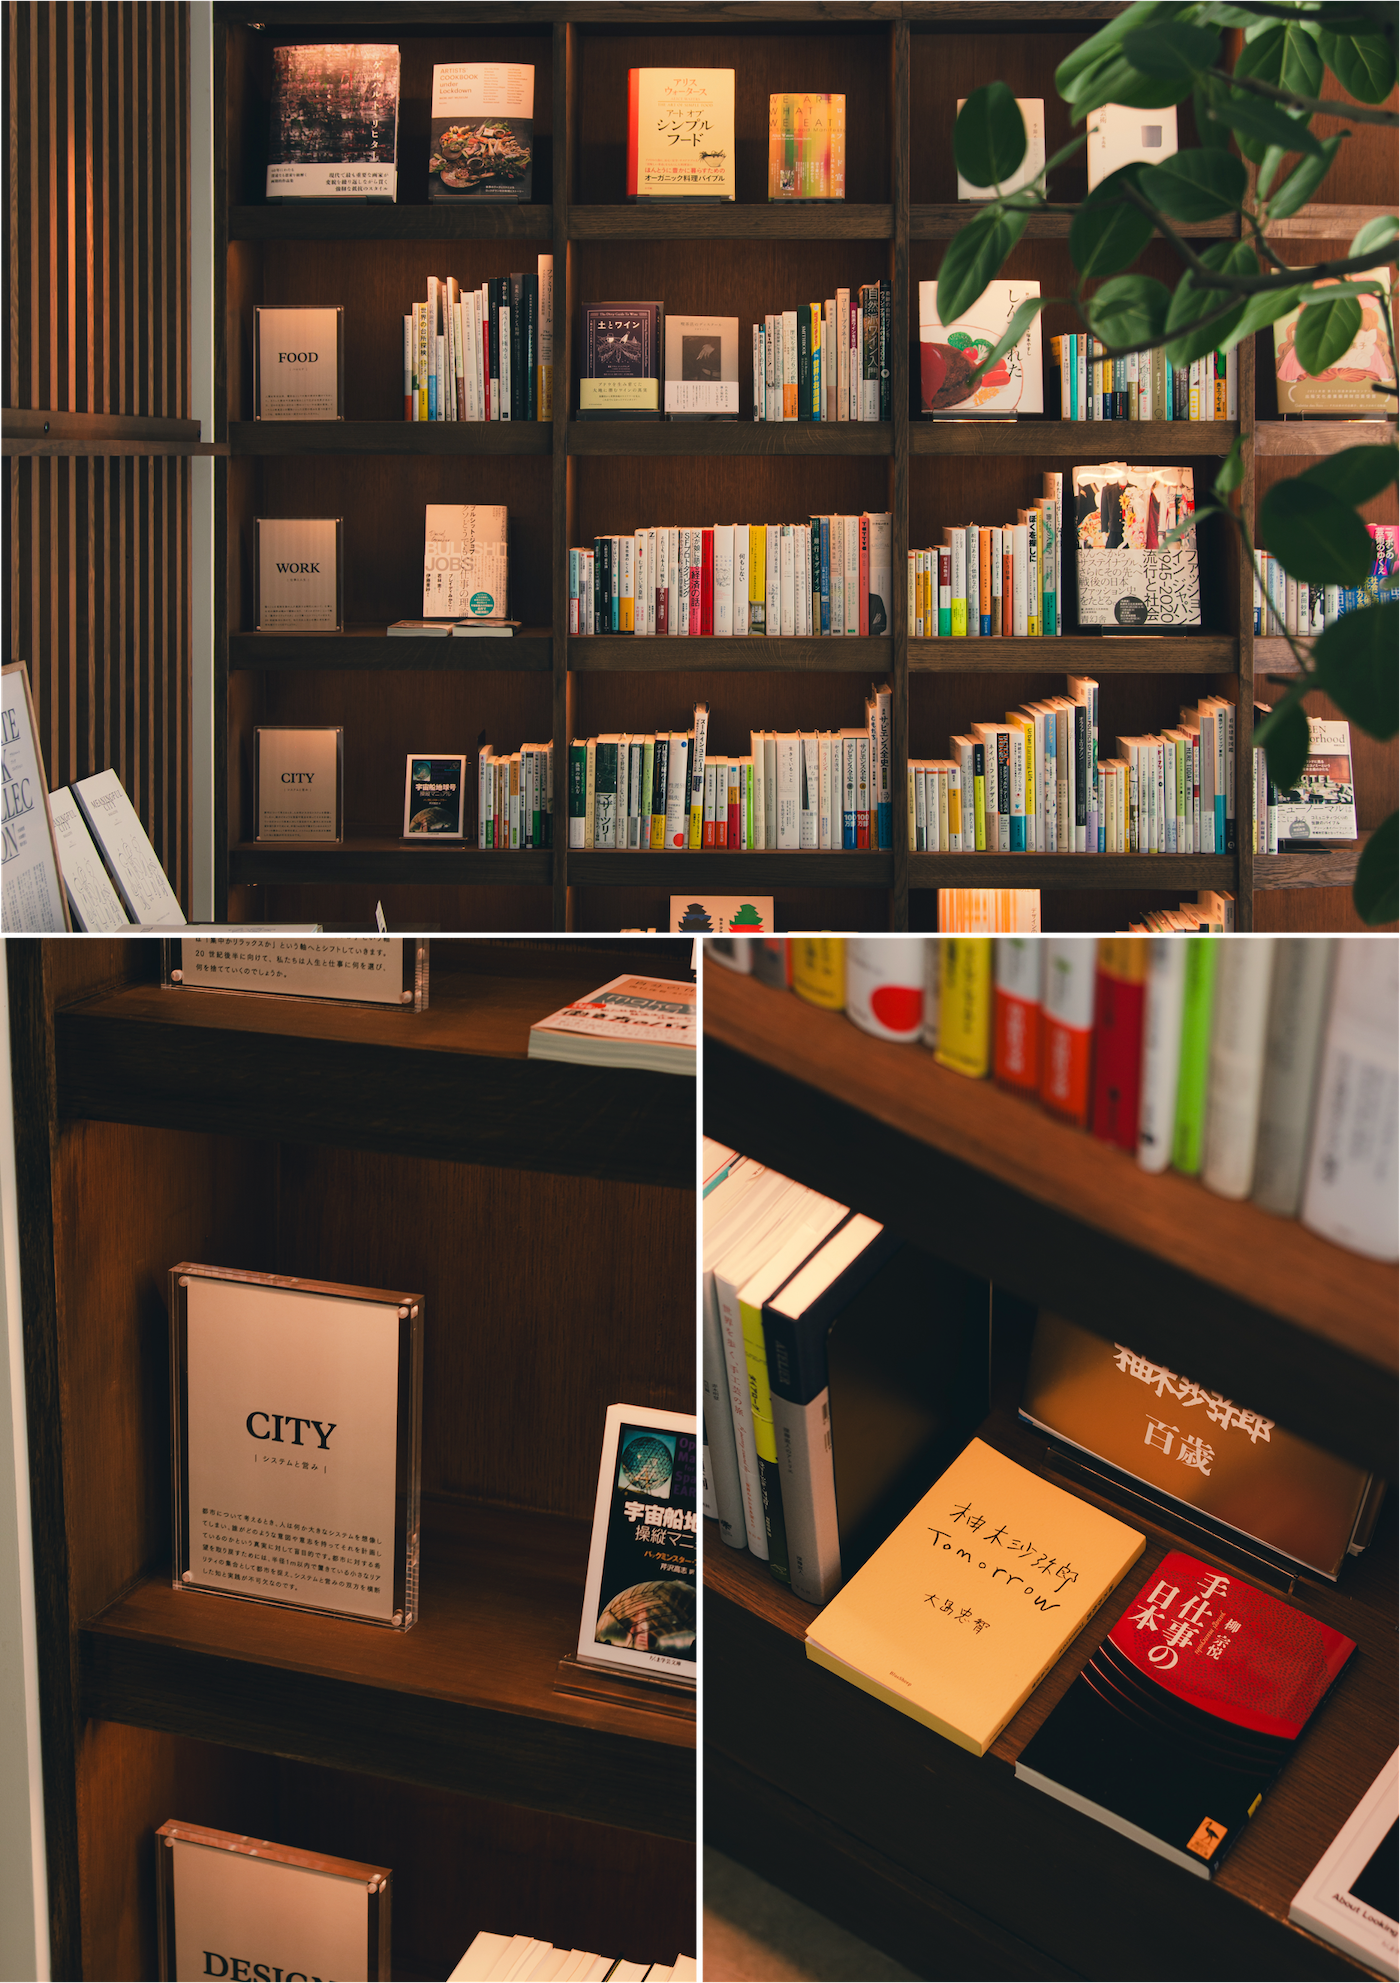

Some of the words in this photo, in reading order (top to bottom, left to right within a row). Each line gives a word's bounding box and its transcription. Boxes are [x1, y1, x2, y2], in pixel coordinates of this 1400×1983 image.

[664, 87, 707, 96] ウォータース
[673, 78, 697, 86] アリス
[370, 60, 382, 161] ゲルハルト・リヒター
[770, 95, 788, 104] WE
[804, 95, 832, 104] ARE
[770, 107, 812, 115] WHAT
[657, 118, 714, 132] シンプル
[804, 118, 832, 126] EAT
[667, 133, 703, 147] フード
[835, 96, 843, 196] スローフード宣言
[597, 320, 640, 330] 土とワイン
[868, 288, 878, 379] 自然派ワイン入門
[278, 353, 318, 363] FOOD
[276, 563, 320, 574] WORK
[426, 557, 474, 571] JOBS
[459, 505, 470, 617] クソどうでもいい仕事の理論
[1078, 559, 1142, 568] サステイナブル、
[1079, 568, 1143, 577] さらにその先へ
[1080, 577, 1129, 587] 戦後の日本
[1080, 586, 1137, 596] ファッション史
[1143, 550, 1159, 621] 流行と社会
[1159, 550, 1173, 623] 1945-2020
[1185, 550, 1201, 622] ファッション
[1080, 596, 1116, 606] をたどる。
[1081, 615, 1106, 623] 青幻舎
[880, 716, 889, 767] サピエンス全史
[1310, 734, 1345, 743] orhood
[281, 773, 315, 783] CITY
[91, 790, 123, 809] MEANINGFUL
[103, 801, 117, 812] CITY
[1278, 805, 1344, 814] ニューノーマル
[600, 795, 612, 842] マザーツリー
[196, 964, 288, 978] 何を捨てていくのでしょうか。
[209, 951, 387, 972] 世紀後半に向けて、私たちは人生と仕事に何を選び、
[722, 1304, 744, 1418] 世界を歩く、手工芸の旅
[775, 1340, 790, 1385] ATELIER
[1112, 1342, 1276, 1444] 柚木沙弥郎
[246, 1411, 337, 1450] CITY
[1144, 1413, 1216, 1477] 百歳
[262, 1455, 318, 1471] システムと営み
[202, 1508, 382, 1545] 都市について考えるとき、人は何か大きなシステムを想像し
[624, 1502, 699, 1533] 宇宙船地
[202, 1520, 382, 1557] てしまい、誰がどのような意図や意志を持ってそれを計画し
[950, 1502, 1078, 1592] 柚木沙弥郎
[202, 1532, 381, 1569] ているのかという真実に対して盲目的です。都市に対する希
[202, 1556, 381, 1594] リティの集合として都市を捉え、システムと営みの双方を横断
[202, 1568, 298, 1591] した知と実践が不可欠なのです。
[927, 1528, 1060, 1612] Tomorrow
[924, 1593, 990, 1634] 大島忠智
[1127, 1580, 1180, 1633] 日本
[1147, 1572, 1232, 1670] 手仕事の
[1224, 1618, 1242, 1634] 柳
[1206, 1634, 1232, 1660] 宗悦
[889, 1670, 912, 1687] BlueSheep
[1332, 1892, 1361, 1915] About
[1362, 1910, 1398, 1938] Looking
[203, 1951, 337, 1983] DESI
